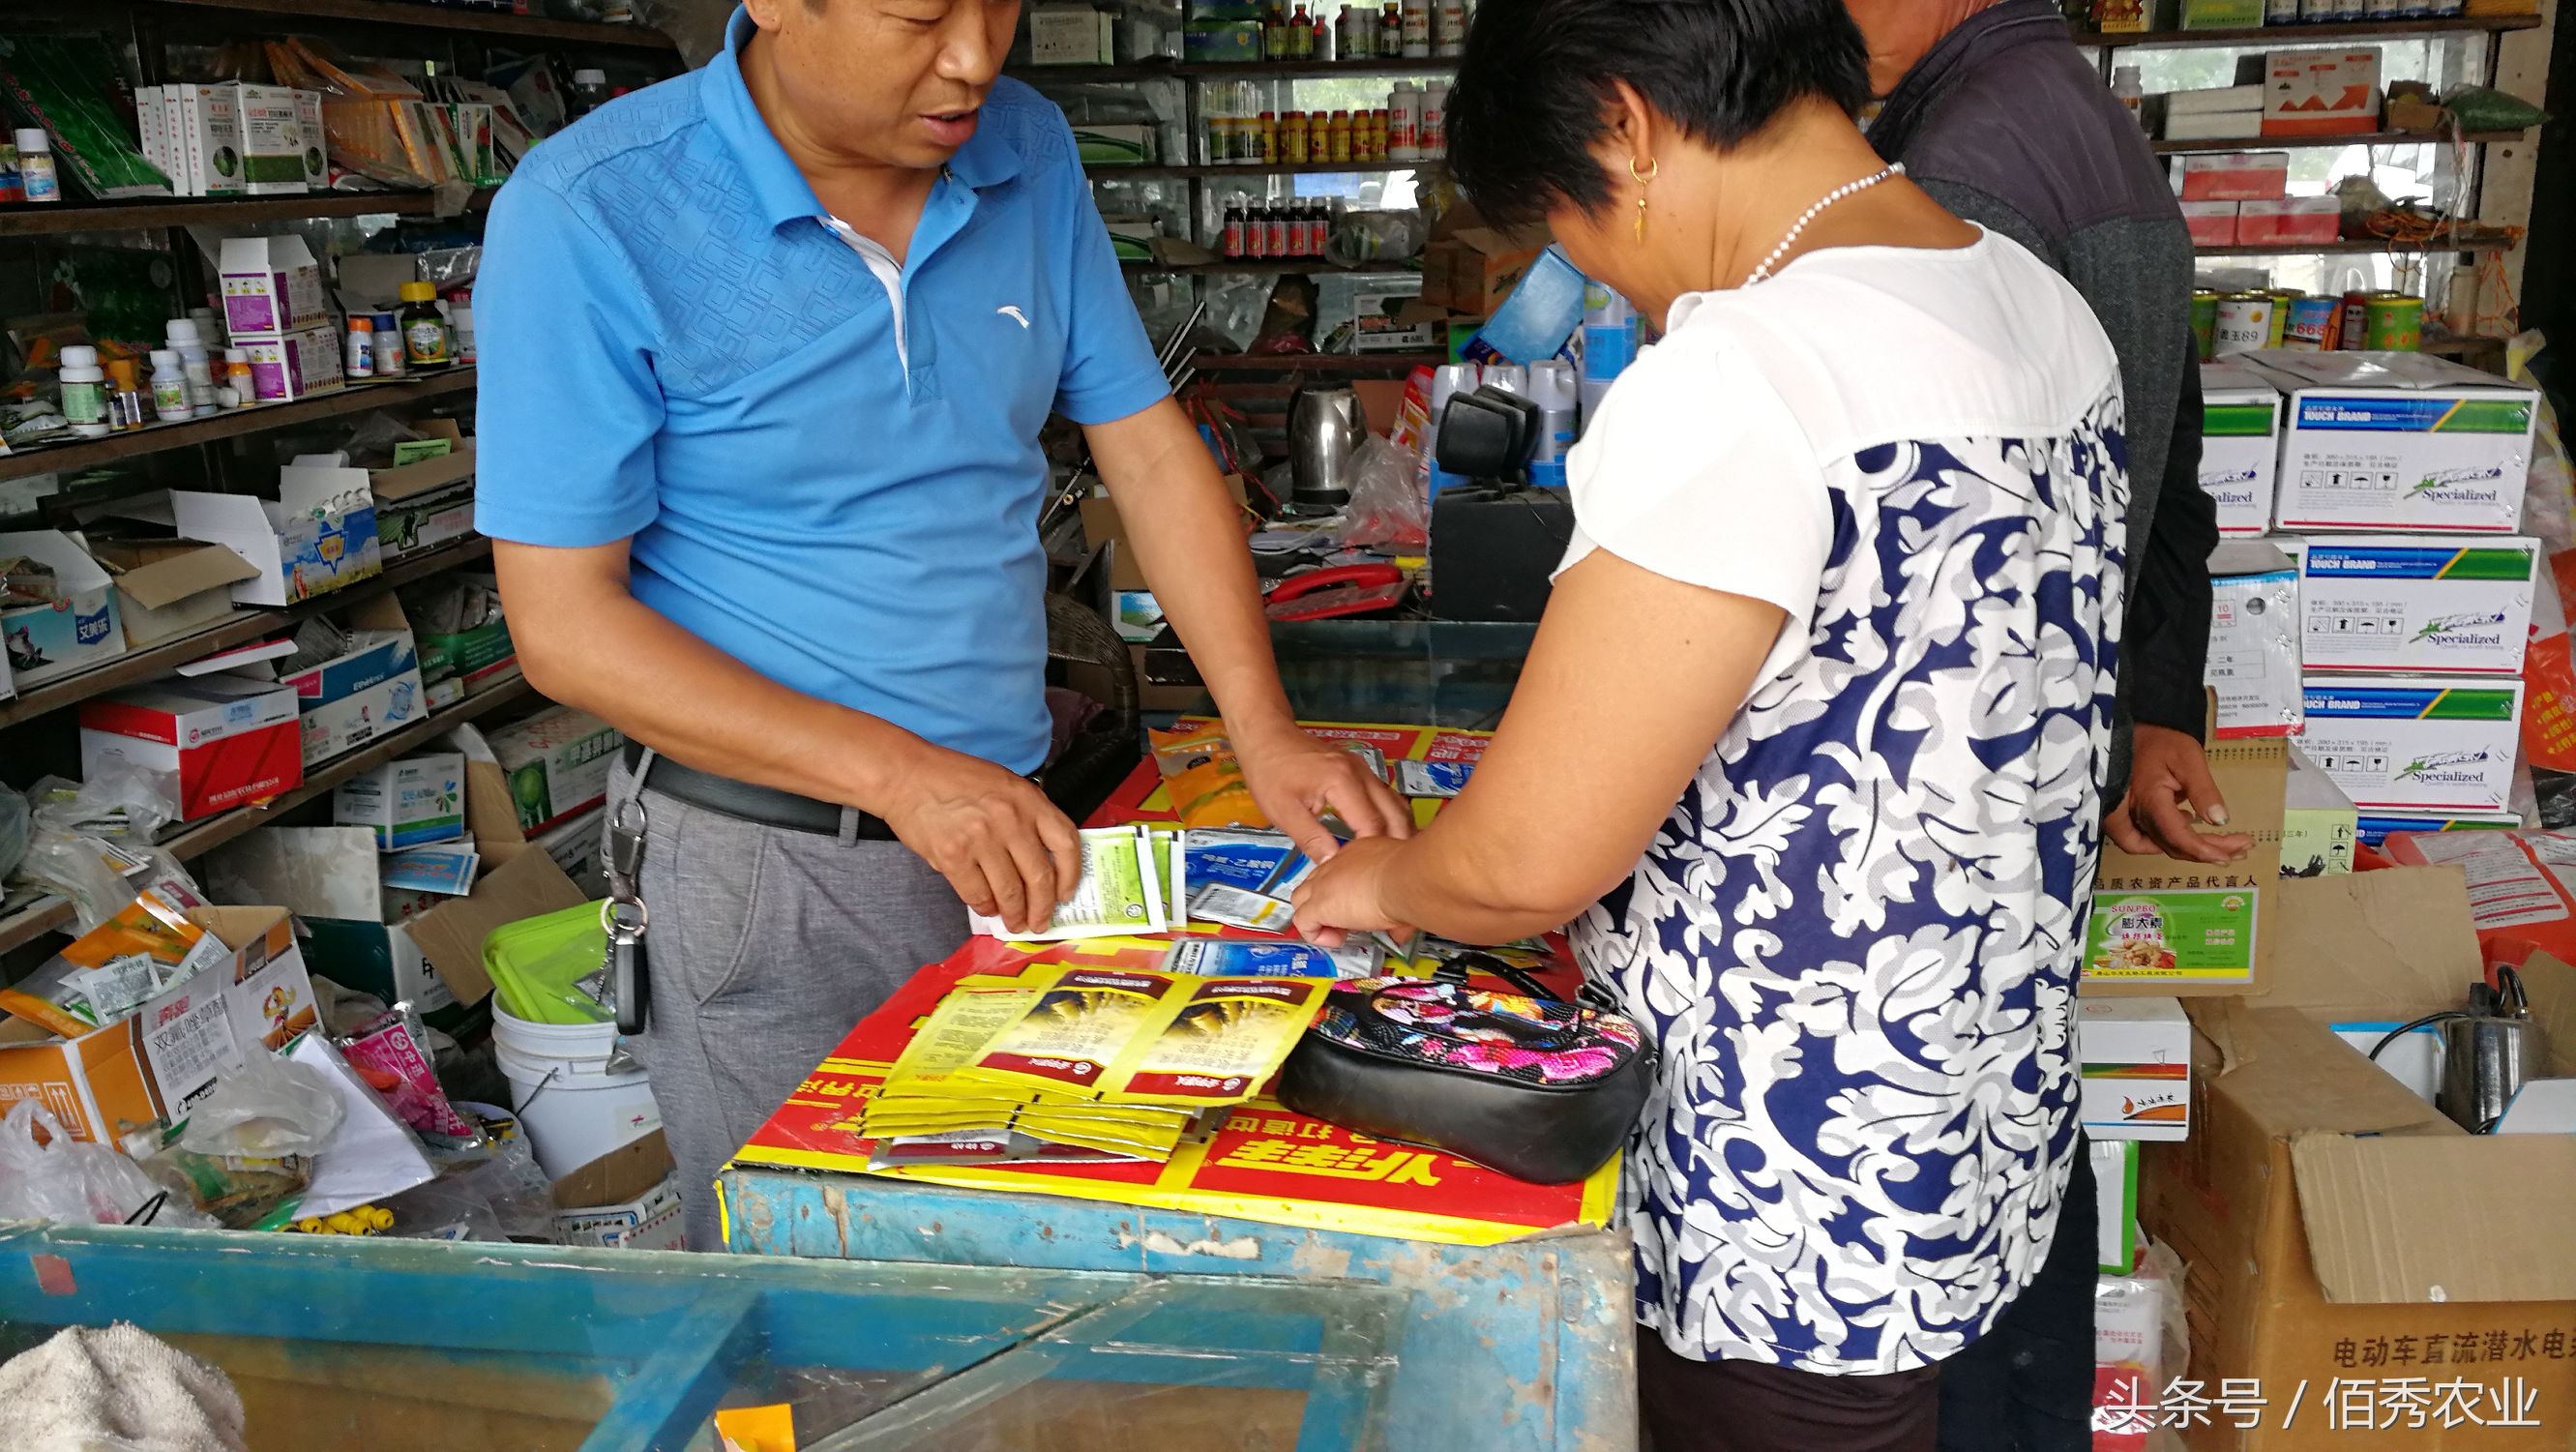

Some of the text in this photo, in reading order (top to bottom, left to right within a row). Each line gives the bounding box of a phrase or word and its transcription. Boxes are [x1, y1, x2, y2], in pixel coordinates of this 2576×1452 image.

[2422, 489, 2497, 502] Specialized
[2428, 633, 2500, 645] Specialized
[2327, 700, 2360, 710] BRAND
[2413, 771, 2484, 783] Specialized
[2333, 1328, 2576, 1368] 电动车直流潜水电
